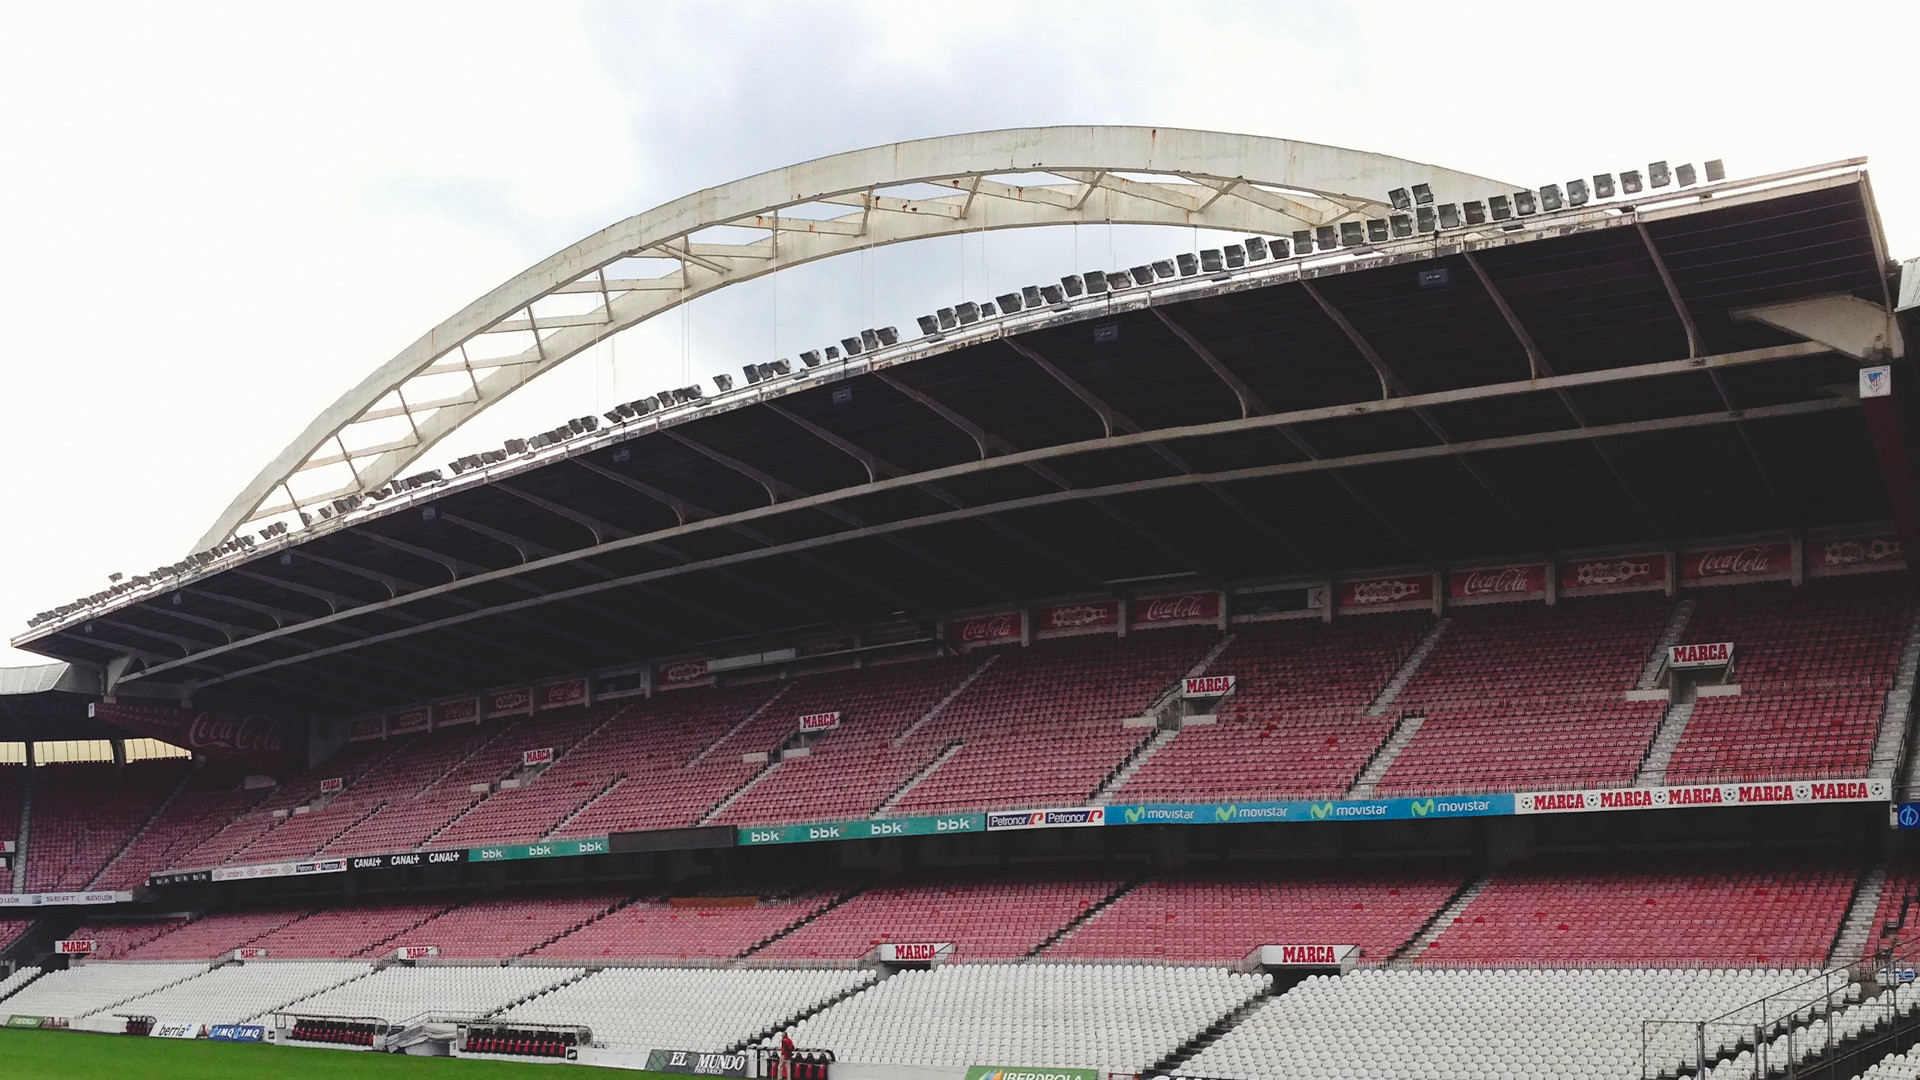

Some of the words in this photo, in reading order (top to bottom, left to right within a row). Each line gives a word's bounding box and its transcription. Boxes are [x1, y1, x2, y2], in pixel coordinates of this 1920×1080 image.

[1673, 644, 1729, 663] MARCA
[1186, 677, 1230, 694] MARCA
[802, 713, 836, 729] MARCA
[526, 750, 551, 763] MARCA
[1533, 793, 1585, 811] MARCA
[1600, 790, 1652, 808] MARCA
[1668, 788, 1722, 805] MARCA
[1738, 785, 1794, 802] MARCA
[1810, 782, 1868, 799] MARCA
[1147, 808, 1195, 821] movistar
[1239, 806, 1288, 819] movistar
[1336, 804, 1388, 816] movistar
[1437, 800, 1491, 812] movistar
[991, 815, 1027, 827] Petronor
[1047, 812, 1084, 824] Petronor
[751, 831, 780, 843] bbk
[809, 827, 840, 839] bbk
[871, 822, 902, 835] bbk
[937, 817, 970, 831] bbk
[482, 850, 502, 859] bbk
[529, 846, 550, 856] bbk
[579, 842, 602, 852] bbk
[354, 858, 382, 868] CANAL+
[391, 855, 420, 866] CANAL+
[428, 852, 460, 863] CANAL+
[227, 870, 243, 878] umbro
[260, 867, 277, 875] umbro
[62, 941, 91, 952] MARCA
[894, 944, 935, 960] MARCA
[1282, 945, 1335, 963] MARCA
[159, 1025, 186, 1037] berria
[241, 1029, 260, 1037] IMQ
[669, 1051, 688, 1066] EL
[697, 1054, 745, 1070] MUNDO
